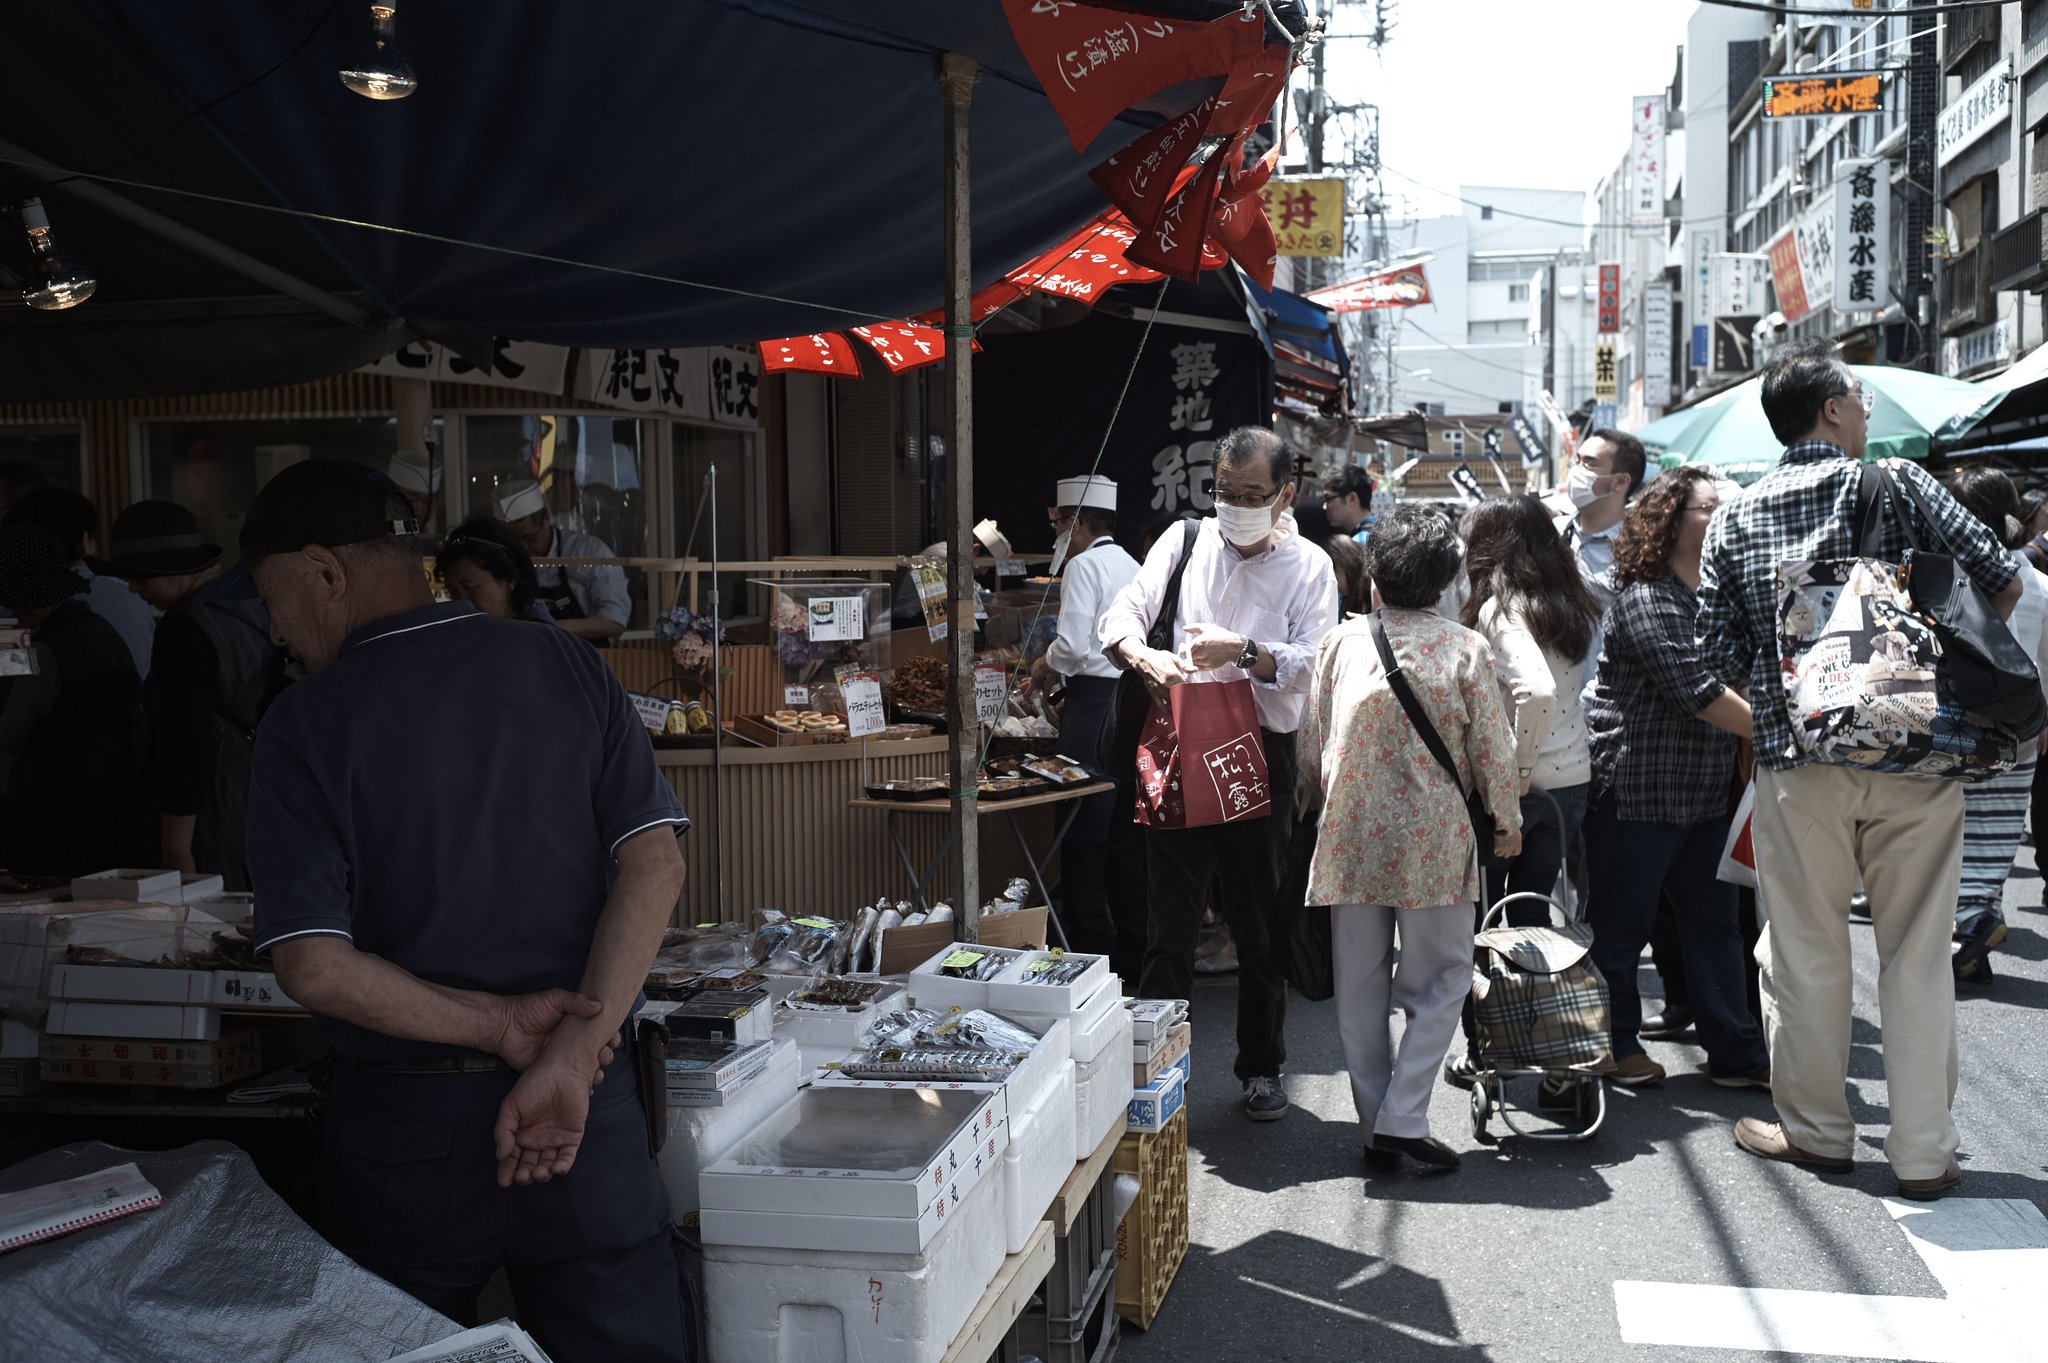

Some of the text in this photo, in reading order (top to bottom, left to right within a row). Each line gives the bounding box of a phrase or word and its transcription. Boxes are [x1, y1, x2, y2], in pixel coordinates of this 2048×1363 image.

[712, 356, 759, 419] 紀文
[1597, 347, 1615, 382] 茶
[1150, 342, 1221, 518] 築地紀
